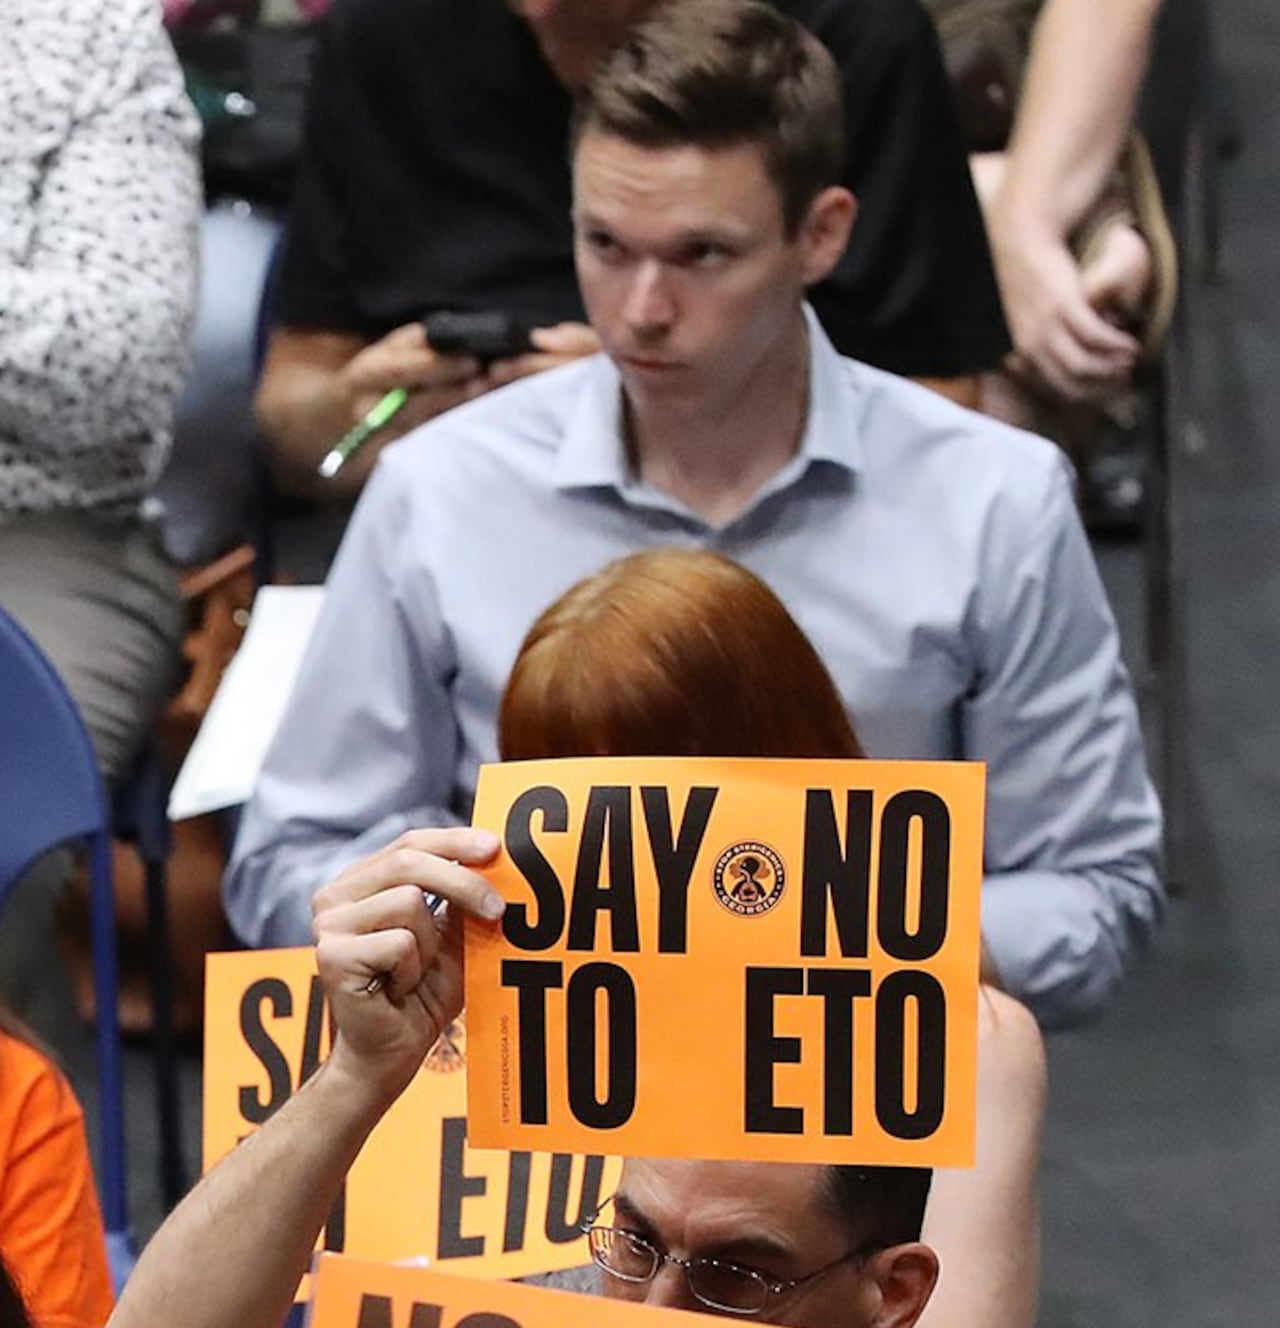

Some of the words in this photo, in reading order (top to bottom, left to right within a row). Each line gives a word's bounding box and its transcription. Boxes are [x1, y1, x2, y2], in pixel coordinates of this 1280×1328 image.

[500, 786, 718, 953] SAY
[801, 789, 950, 960] NO
[502, 960, 636, 1129] TO
[745, 967, 945, 1139] ETO
